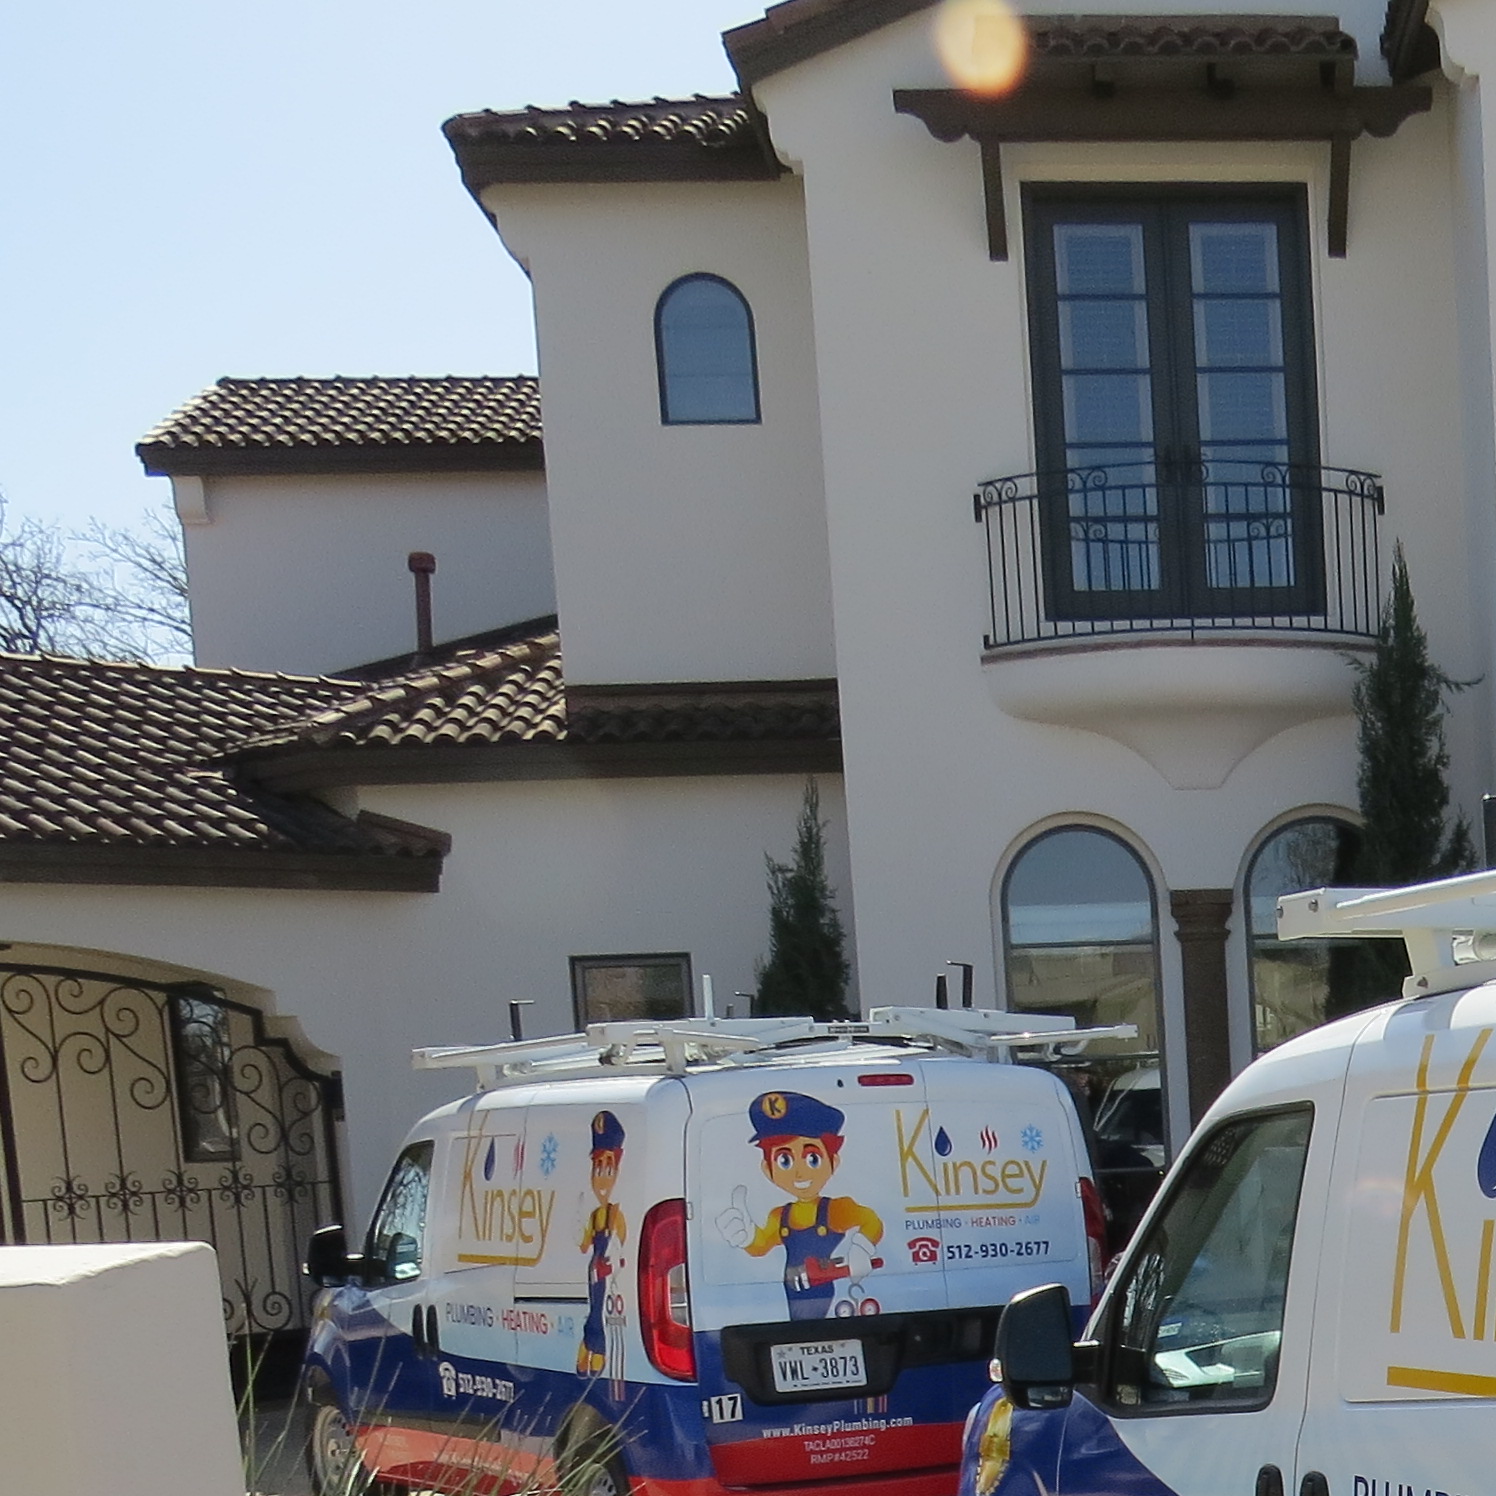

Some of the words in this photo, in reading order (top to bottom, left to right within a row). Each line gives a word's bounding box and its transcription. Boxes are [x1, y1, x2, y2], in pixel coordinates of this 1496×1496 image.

[767, 1097, 780, 1115] K
[895, 1108, 1048, 1213] Kinsey
[457, 1110, 555, 1267] Kinsey
[905, 1218, 962, 1231] PLUMBING
[971, 1216, 1016, 1227] HEATING
[947, 1241, 1050, 1260] 512-930-2677
[446, 1303, 494, 1328] PLUMBING
[502, 1309, 549, 1335] HEATING
[800, 1344, 834, 1356] TEXAS
[821, 1356, 860, 1378] 3873
[715, 1396, 739, 1421] 17
[762, 1416, 913, 1439] www.KinseyPlumbing.com
